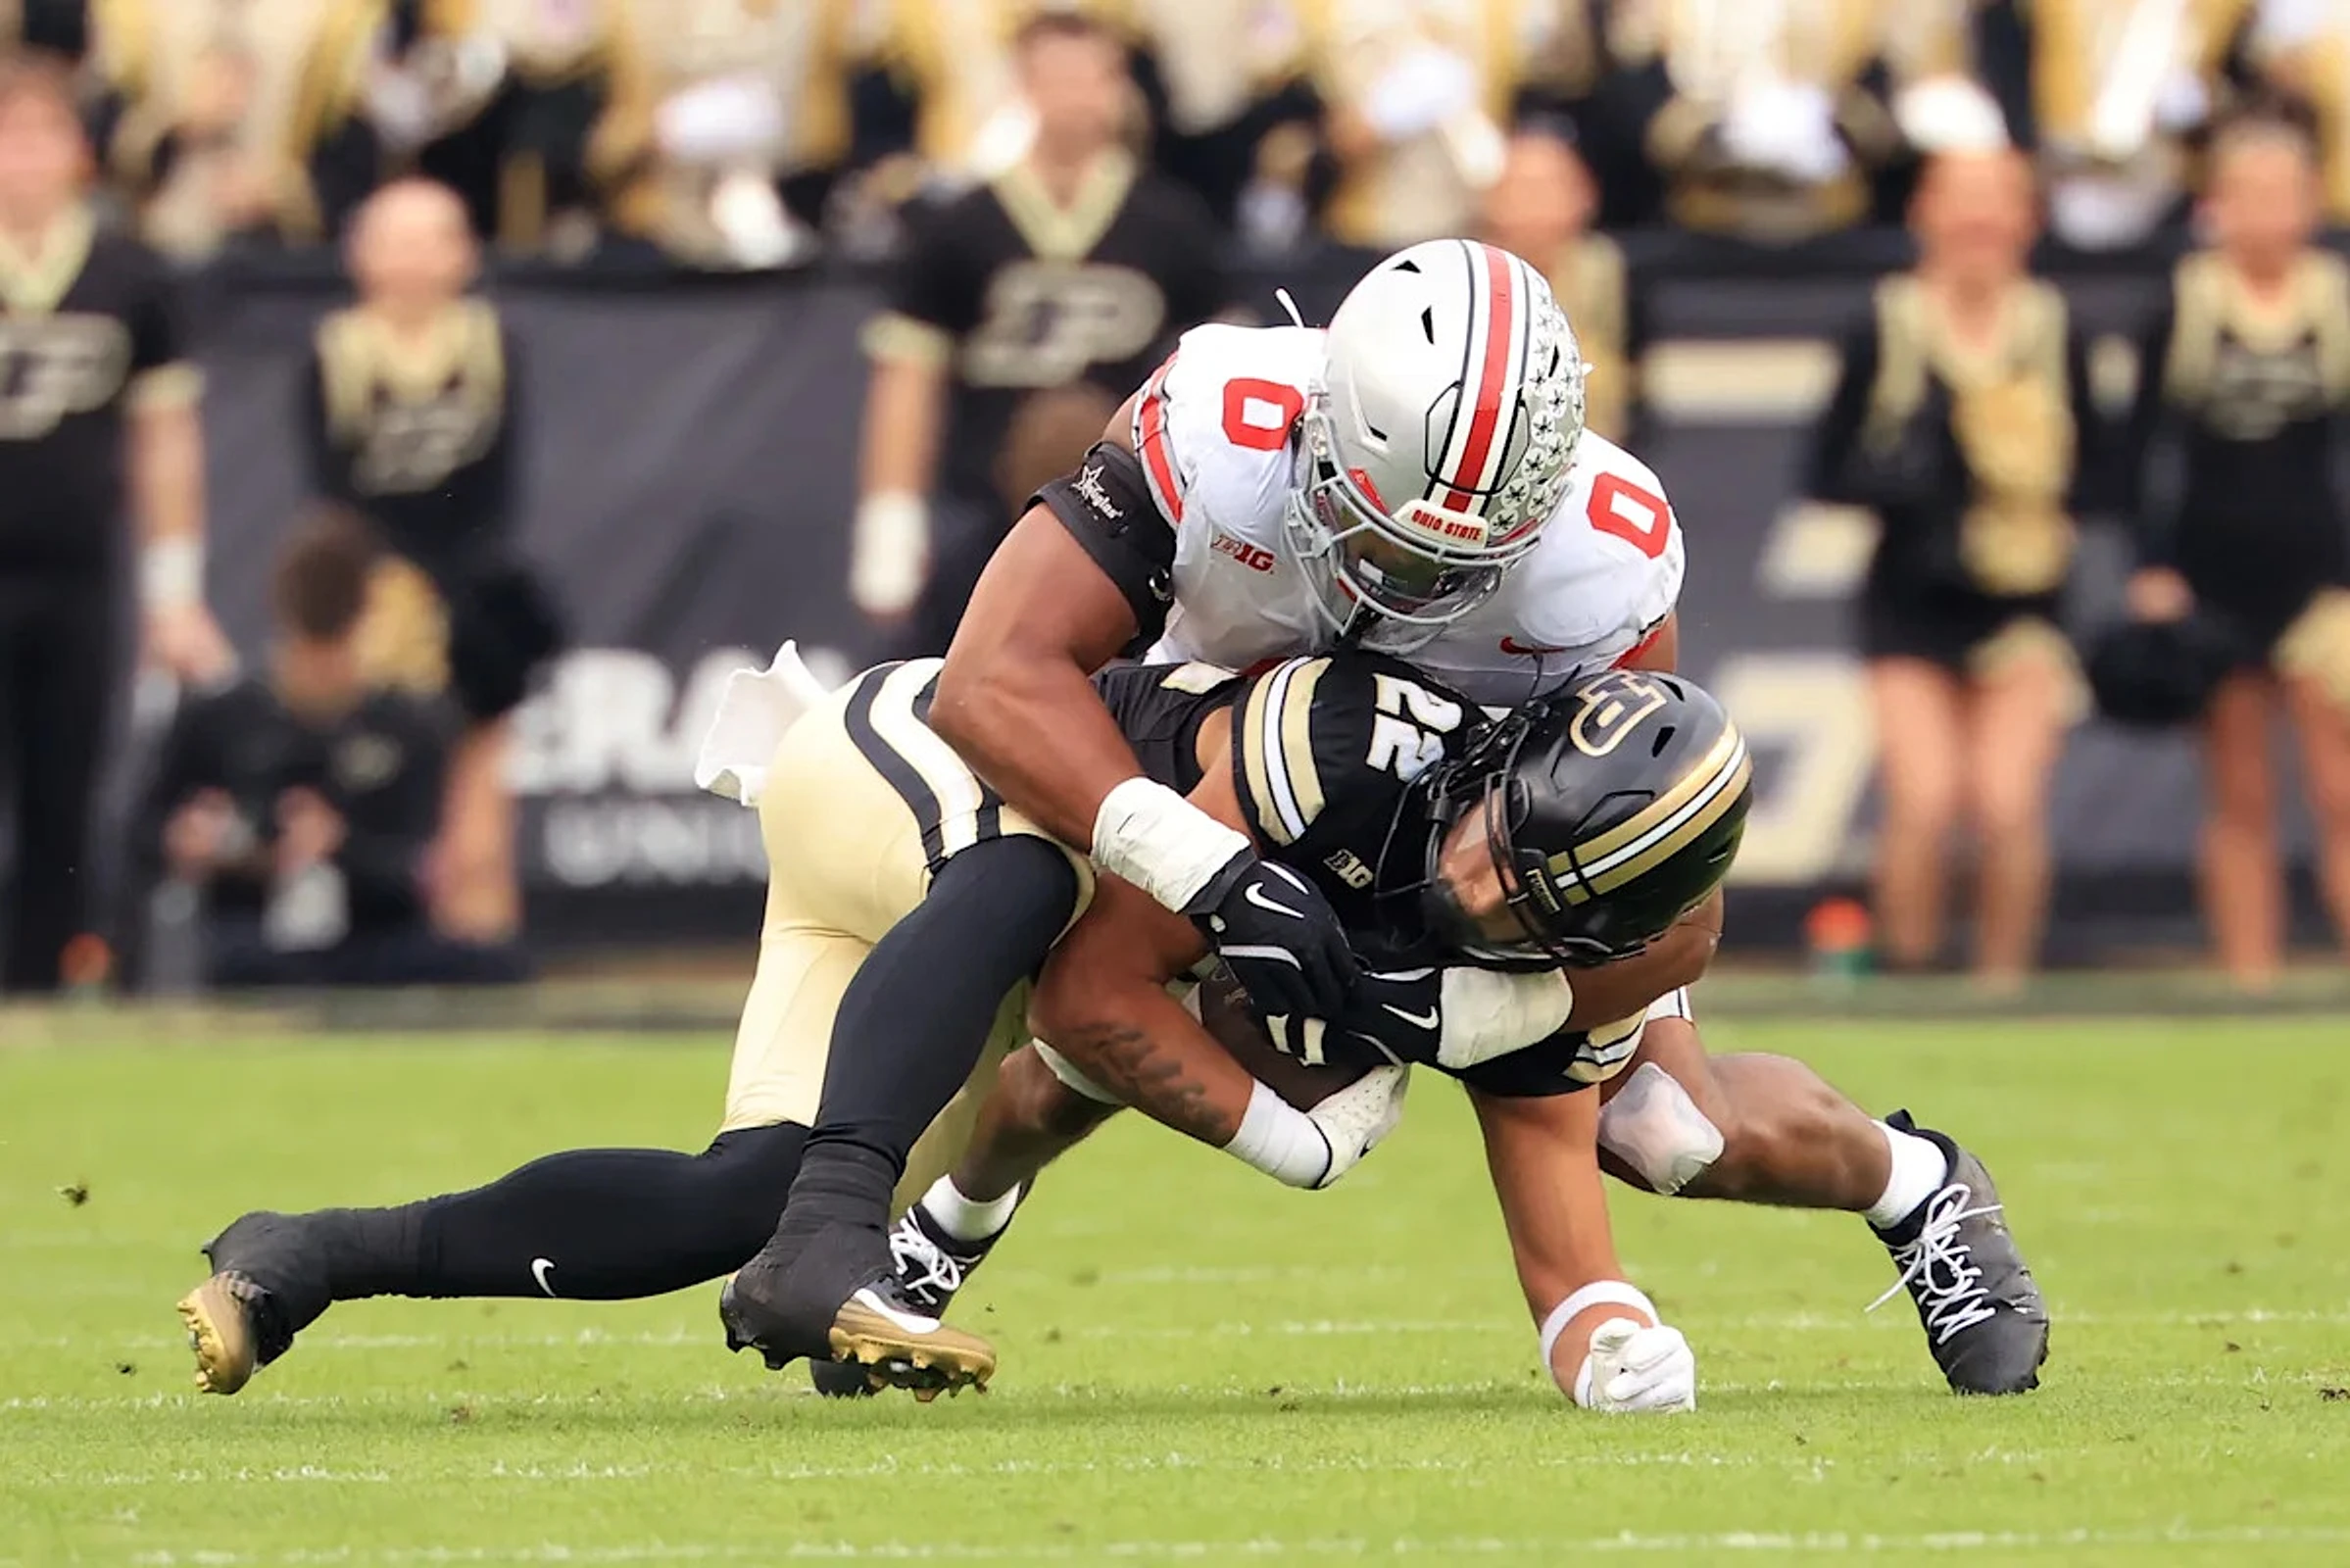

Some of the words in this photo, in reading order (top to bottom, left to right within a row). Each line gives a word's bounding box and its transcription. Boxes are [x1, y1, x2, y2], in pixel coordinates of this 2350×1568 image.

[1221, 377, 1304, 452] 0
[1411, 510, 1443, 530] OHIO
[1444, 522, 1483, 541] STATE
[1587, 471, 1671, 560] 0
[1366, 672, 1463, 783] 22
